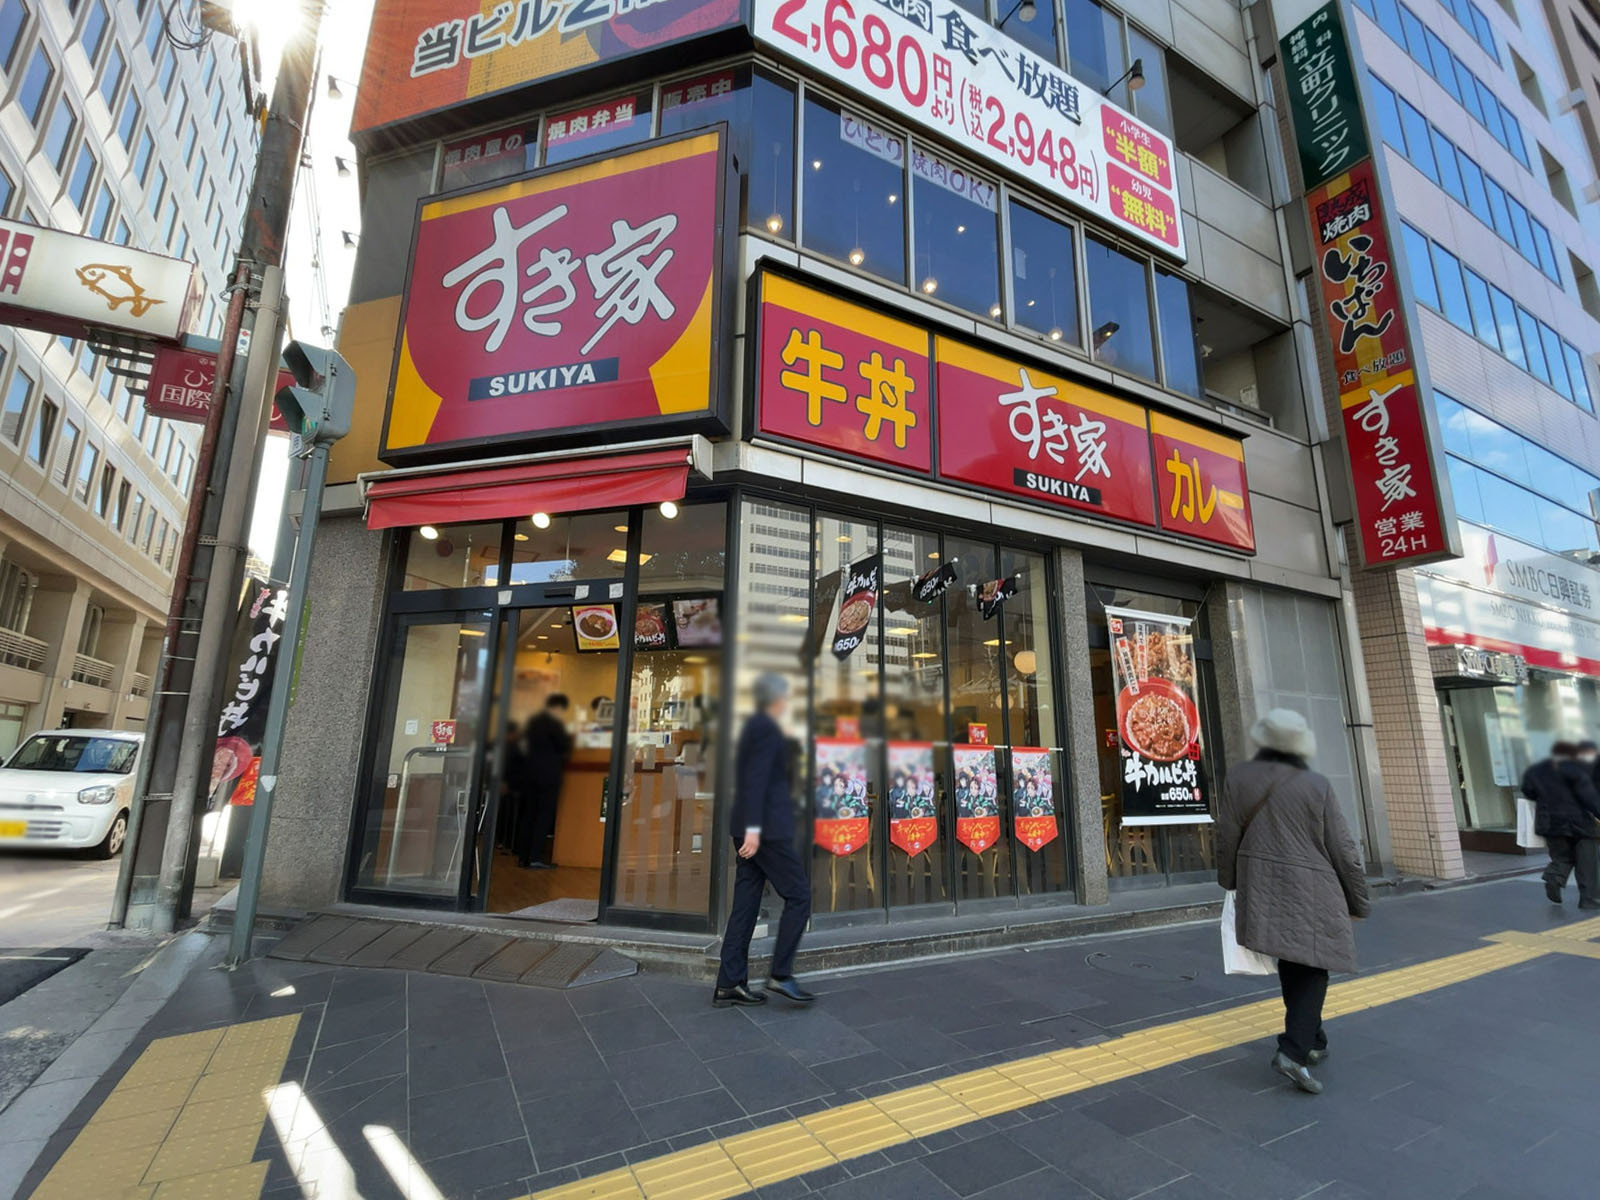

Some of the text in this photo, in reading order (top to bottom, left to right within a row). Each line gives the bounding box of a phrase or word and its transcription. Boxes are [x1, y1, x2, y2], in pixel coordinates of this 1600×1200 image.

[937, 9, 1081, 126] 食べ放題
[547, 103, 634, 141] 焼肉弁当
[1298, 45, 1350, 176] 立町クリニック
[842, 117, 903, 160] ひとり
[1120, 119, 1152, 148] 小学生
[1323, 202, 1371, 244] 焼肉
[442, 203, 678, 356] すき家
[1322, 234, 1395, 354] いちばん
[488, 363, 597, 397] SUKIYA
[780, 327, 918, 449] 牛丼
[1343, 349, 1405, 385] 食べ放題
[998, 367, 1113, 483] すき家
[1352, 383, 1417, 512] すき家
[1026, 472, 1091, 503] SUKIYA
[1166, 447, 1245, 524] カレー
[1374, 510, 1425, 538] 営業
[1380, 534, 1427, 557] 24H
[1125, 751, 1197, 792] 牛カルビ丼
